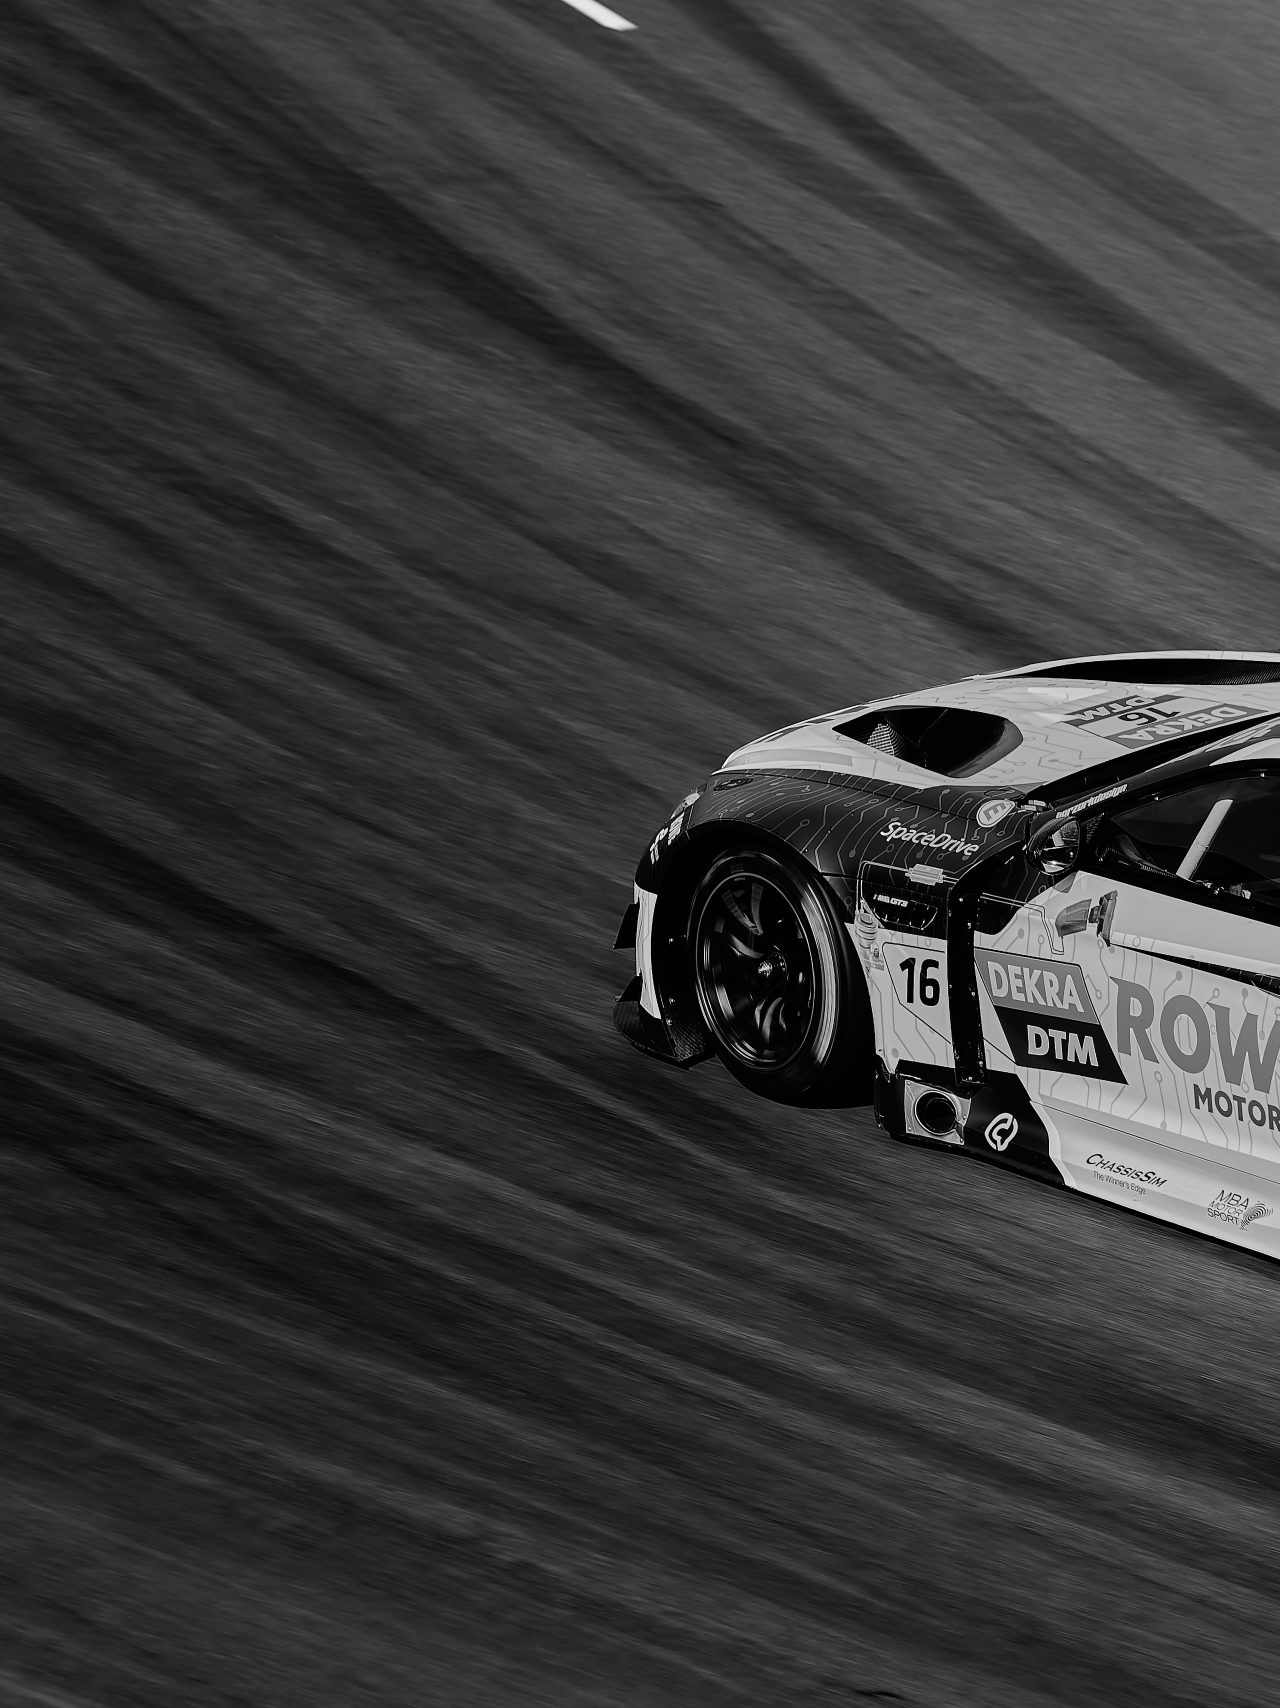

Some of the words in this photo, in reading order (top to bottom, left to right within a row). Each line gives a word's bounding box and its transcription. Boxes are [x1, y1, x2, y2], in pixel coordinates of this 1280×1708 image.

[1074, 696, 1155, 720] DTM
[1117, 707, 1181, 726] 16
[1117, 706, 1248, 741] DEKRA
[880, 821, 979, 856] SpaceDrive
[899, 956, 942, 1007] 16
[987, 961, 1085, 1014] DEKRA
[1027, 1025, 1100, 1067] DTM
[1093, 1170, 1105, 1182] The
[1130, 1183, 1147, 1195] Edge
[1215, 1189, 1250, 1210] MBA
[1207, 1207, 1240, 1225] SPORT
